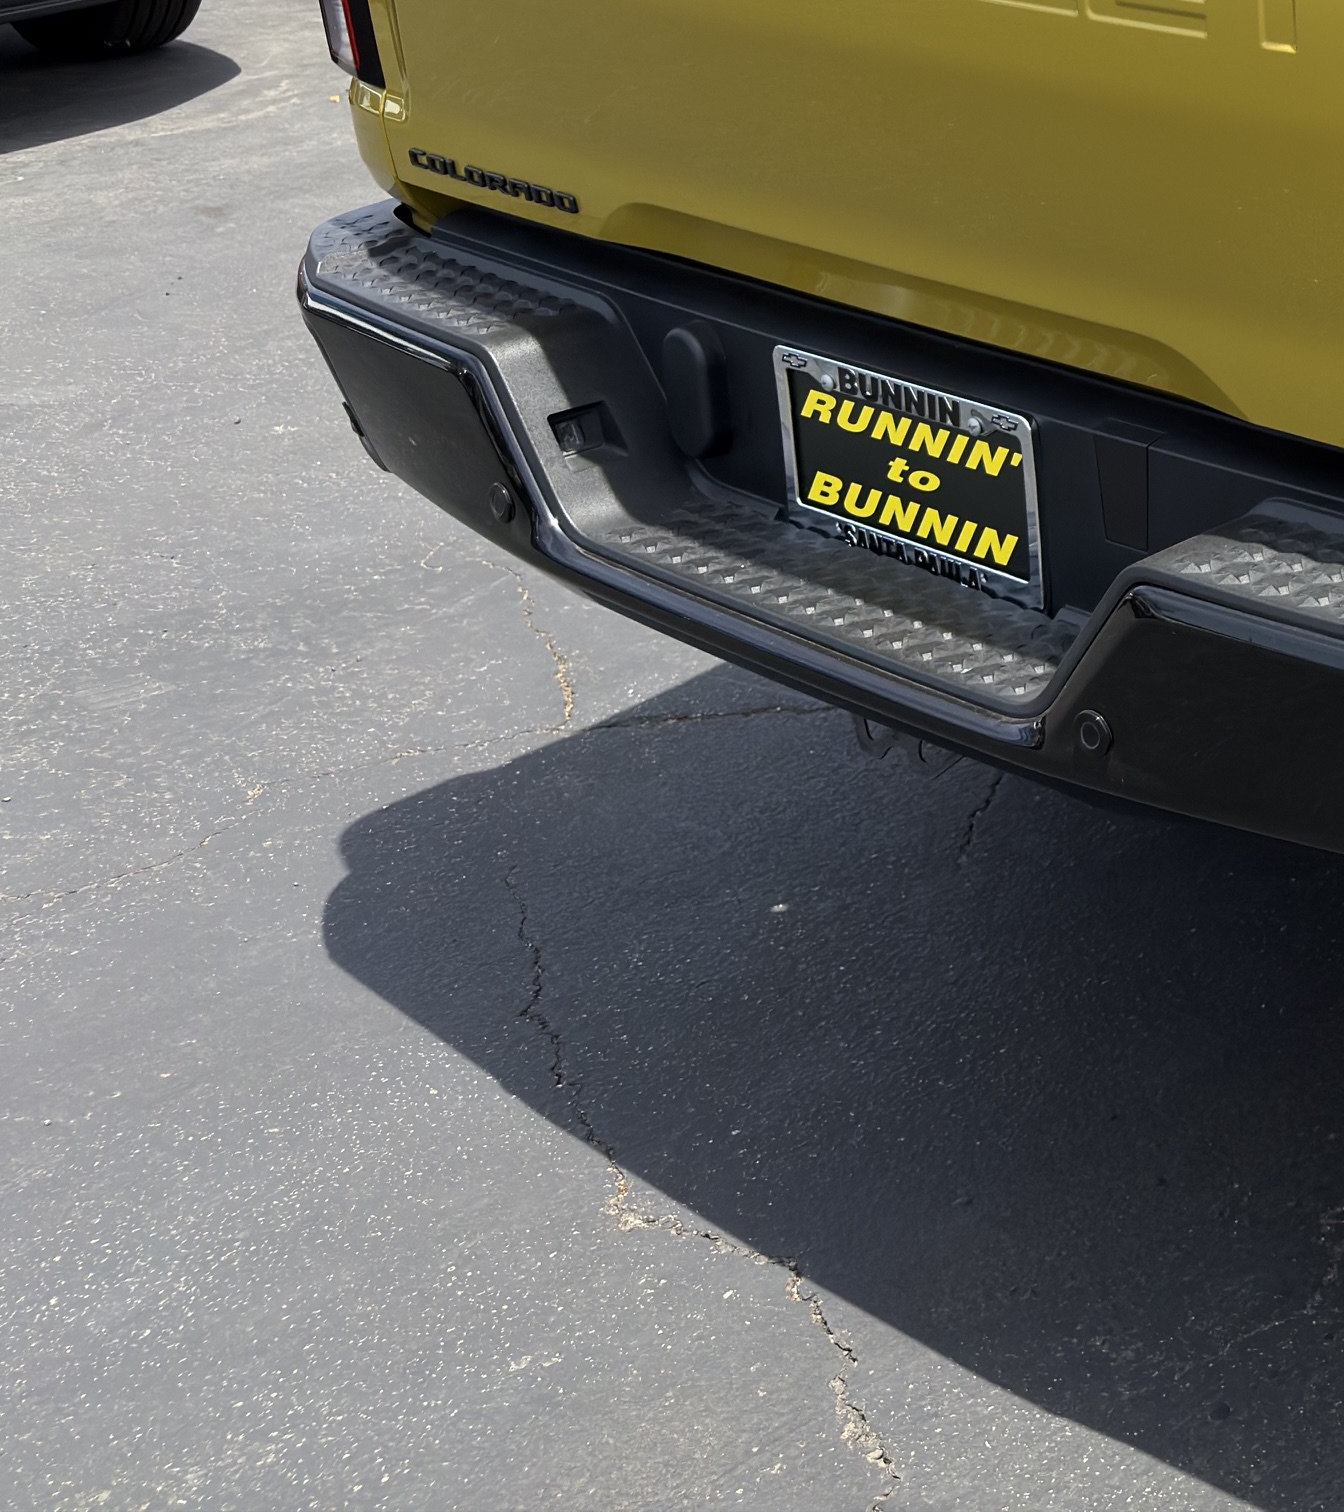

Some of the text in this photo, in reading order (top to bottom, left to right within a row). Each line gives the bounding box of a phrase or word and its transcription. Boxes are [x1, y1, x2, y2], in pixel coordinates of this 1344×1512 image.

[408, 146, 580, 214] COLORADO
[837, 366, 961, 428] BUNNIN
[800, 388, 1023, 477] RUNNIN'
[887, 456, 941, 492] to
[807, 470, 1019, 566] BUNNIN
